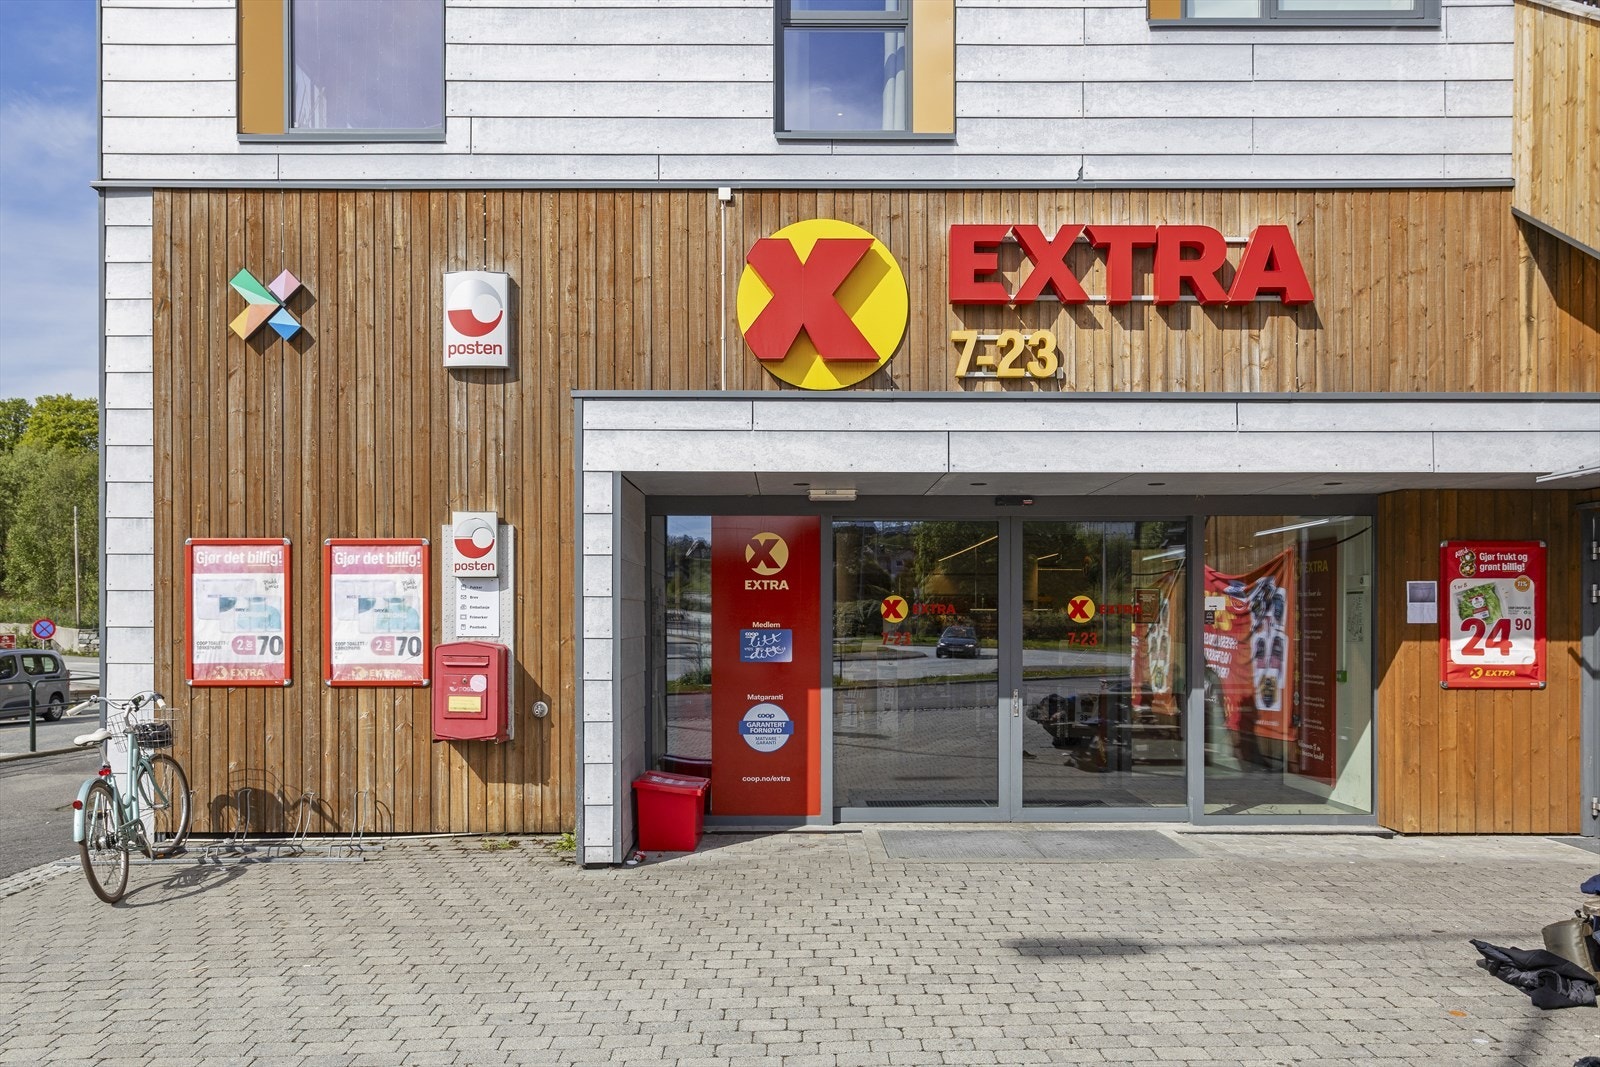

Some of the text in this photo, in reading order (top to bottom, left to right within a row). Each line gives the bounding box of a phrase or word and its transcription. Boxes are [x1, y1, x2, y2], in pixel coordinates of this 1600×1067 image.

[949, 224, 1315, 306] EXTRA
[448, 341, 503, 358] posten
[951, 329, 1058, 379] 7-23
[196, 551, 282, 567] Gjør det billig!
[334, 551, 421, 567] Gjør det billig!
[1479, 552, 1528, 563] Gjør frukt og
[454, 560, 495, 573] posten
[1479, 562, 1525, 572] grønt billig!
[744, 579, 790, 590] EXTRA
[912, 604, 956, 615] EXTRA
[1099, 604, 1143, 615] EXTRA
[881, 631, 912, 646] 7-23
[1067, 632, 1098, 647] 7-23
[1460, 618, 1531, 656] 24 90
[236, 639, 244, 651] 2
[257, 635, 284, 656] 70
[375, 639, 383, 651] 2
[396, 636, 422, 657] 70
[230, 669, 265, 678] EXTRA
[747, 693, 784, 702] Matgaranti
[742, 775, 791, 783] coop.no/extra
